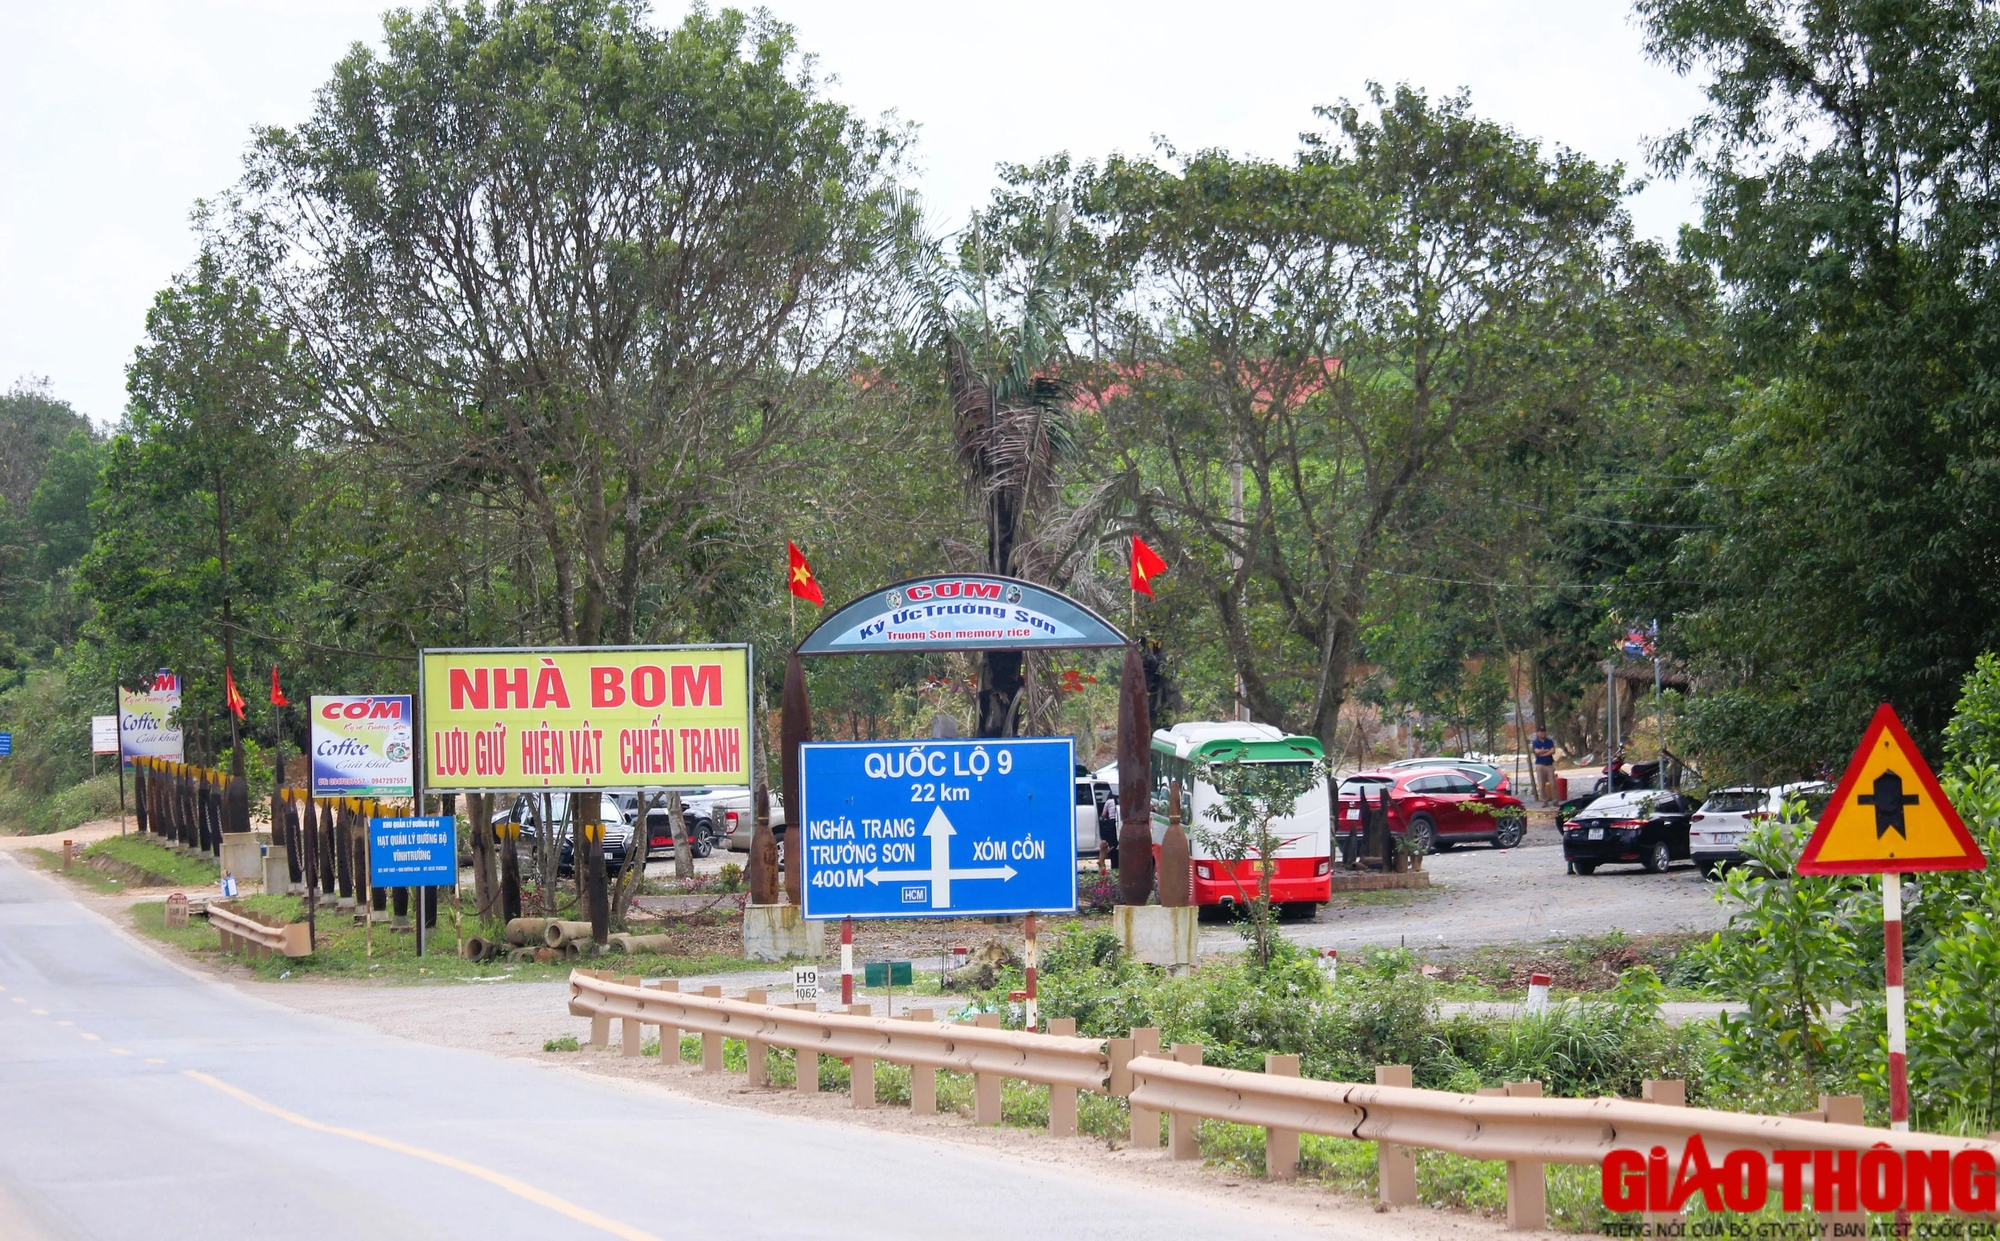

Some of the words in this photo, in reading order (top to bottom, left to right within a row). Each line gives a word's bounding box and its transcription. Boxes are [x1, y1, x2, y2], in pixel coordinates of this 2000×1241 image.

[906, 581, 1002, 601] CƠM
[860, 619, 885, 640] Ký
[1014, 610, 1056, 635] Sơn
[887, 630, 926, 640] Truong
[930, 630, 952, 639] Son
[956, 629, 1003, 638] memory
[1007, 628, 1030, 637] rice
[449, 657, 571, 711] NHÀ
[590, 664, 723, 709] BOM
[322, 698, 401, 719] CƠM
[122, 711, 161, 731] Coffee
[317, 737, 369, 756] Coffee
[434, 726, 470, 777] LƯU
[474, 721, 507, 776] GIỮ
[521, 720, 565, 786] HIỆN
[569, 720, 603, 786] VẬT
[619, 714, 675, 775] CHIẾN
[680, 728, 741, 774] TRANH
[864, 745, 947, 780] QUỐC
[953, 745, 990, 782] LỘ
[997, 749, 1013, 775] 9
[910, 783, 935, 802] 22
[940, 783, 970, 801] km
[810, 816, 855, 840] NGHĨA
[862, 818, 915, 839] TRANG
[377, 835, 389, 848] HẠT
[408, 832, 416, 845] LÝ
[438, 831, 447, 846] BỘ
[973, 836, 1007, 861] XÓM
[1012, 832, 1045, 860] CỒN
[810, 841, 877, 865] TRƯỜNG
[882, 843, 915, 863] SƠN
[905, 889, 924, 901] HCM
[796, 971, 816, 983] H9
[795, 988, 817, 998] 1062
